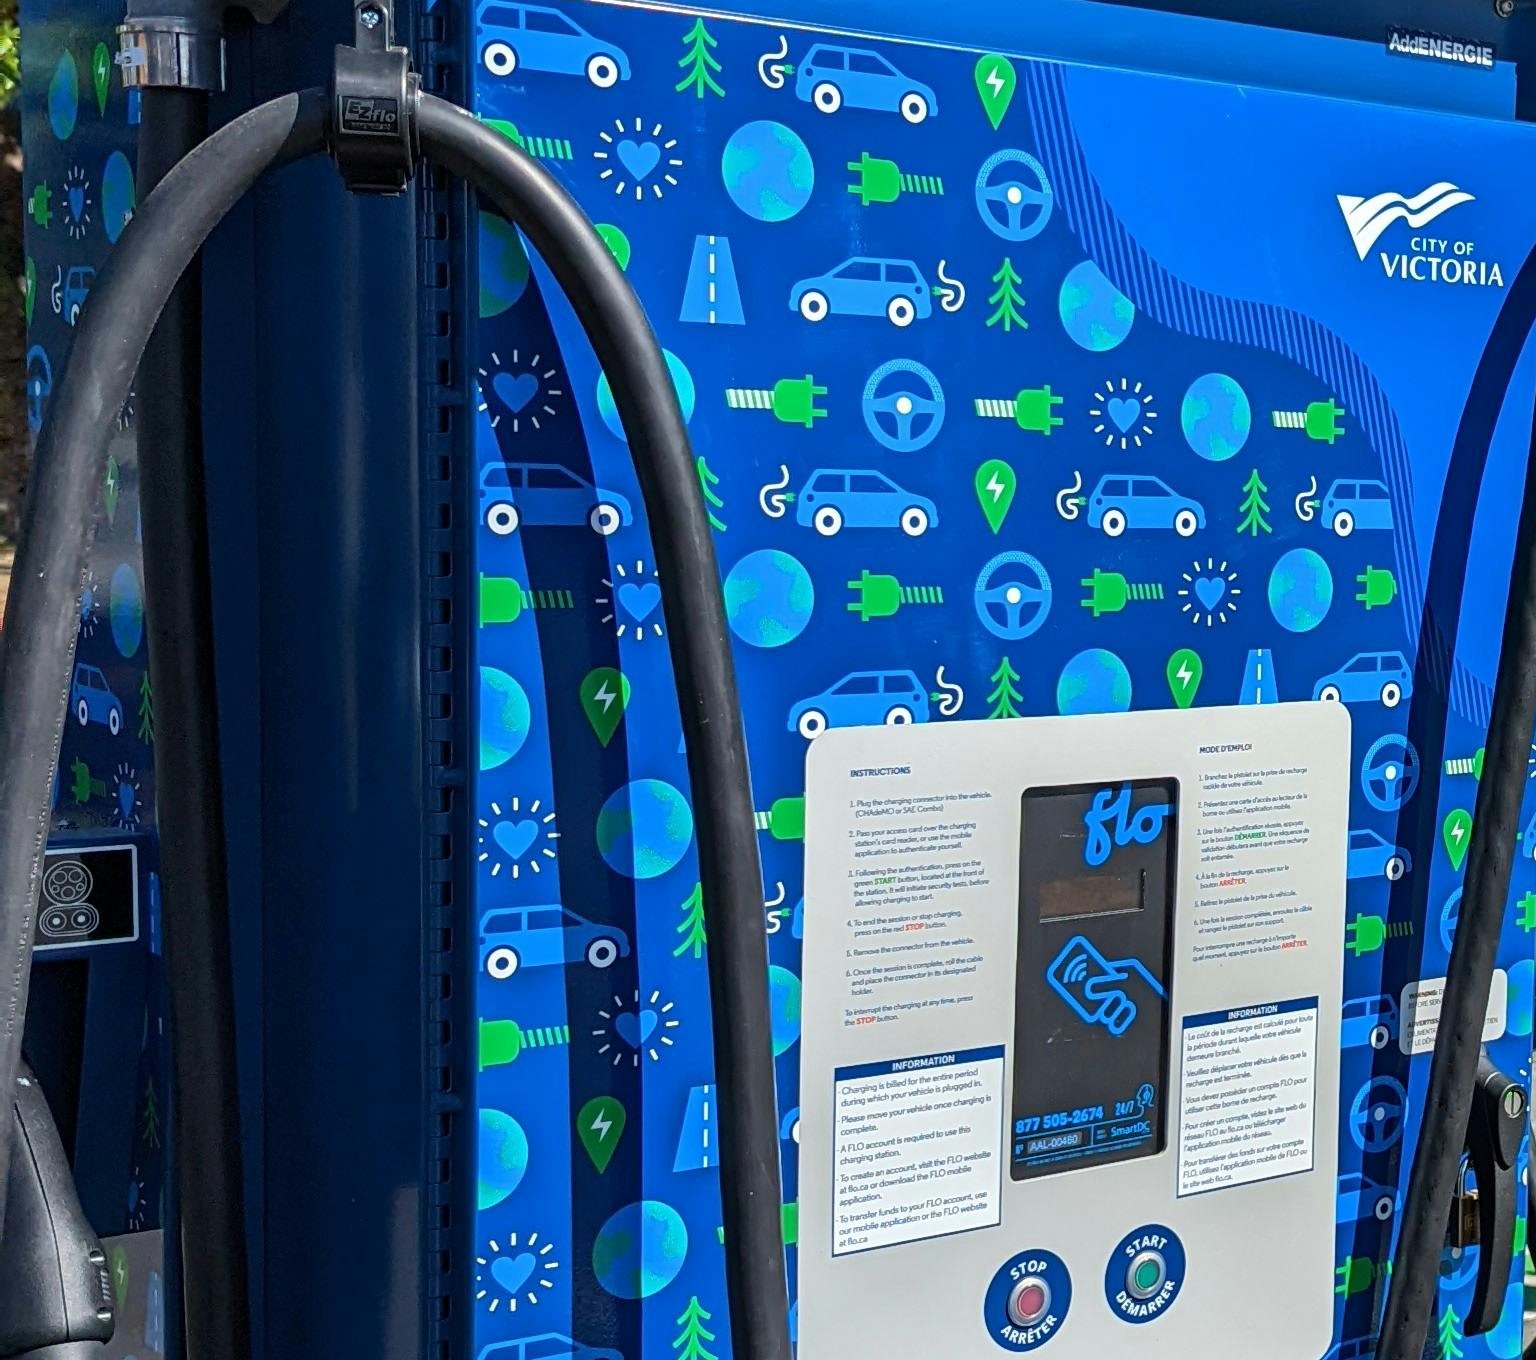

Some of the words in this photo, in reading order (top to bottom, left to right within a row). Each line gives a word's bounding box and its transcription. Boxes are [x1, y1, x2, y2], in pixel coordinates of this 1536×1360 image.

[1390, 32, 1492, 66] AddENERGIE
[1411, 238, 1447, 253] CITY
[1454, 242, 1473, 255] OF
[1380, 253, 1503, 287] VICTORIA
[1200, 745, 1220, 753] MODE
[850, 766, 911, 777] INSTRUCTIONS
[1085, 780, 1174, 866] flo
[1228, 1005, 1278, 1020] INFORMATION
[892, 1054, 955, 1071] INFORMATION
[1115, 1100, 1134, 1116] 24/7
[1016, 1117, 1040, 1134] 877
[1043, 1106, 1104, 1129] 505-2674
[1111, 1121, 1150, 1137] SmartDC
[1126, 1235, 1167, 1257] START
[1010, 1260, 1047, 1280] STOP
[1116, 1280, 1175, 1317] DÉMARRER
[1000, 1315, 1058, 1345] ARRÊTER
